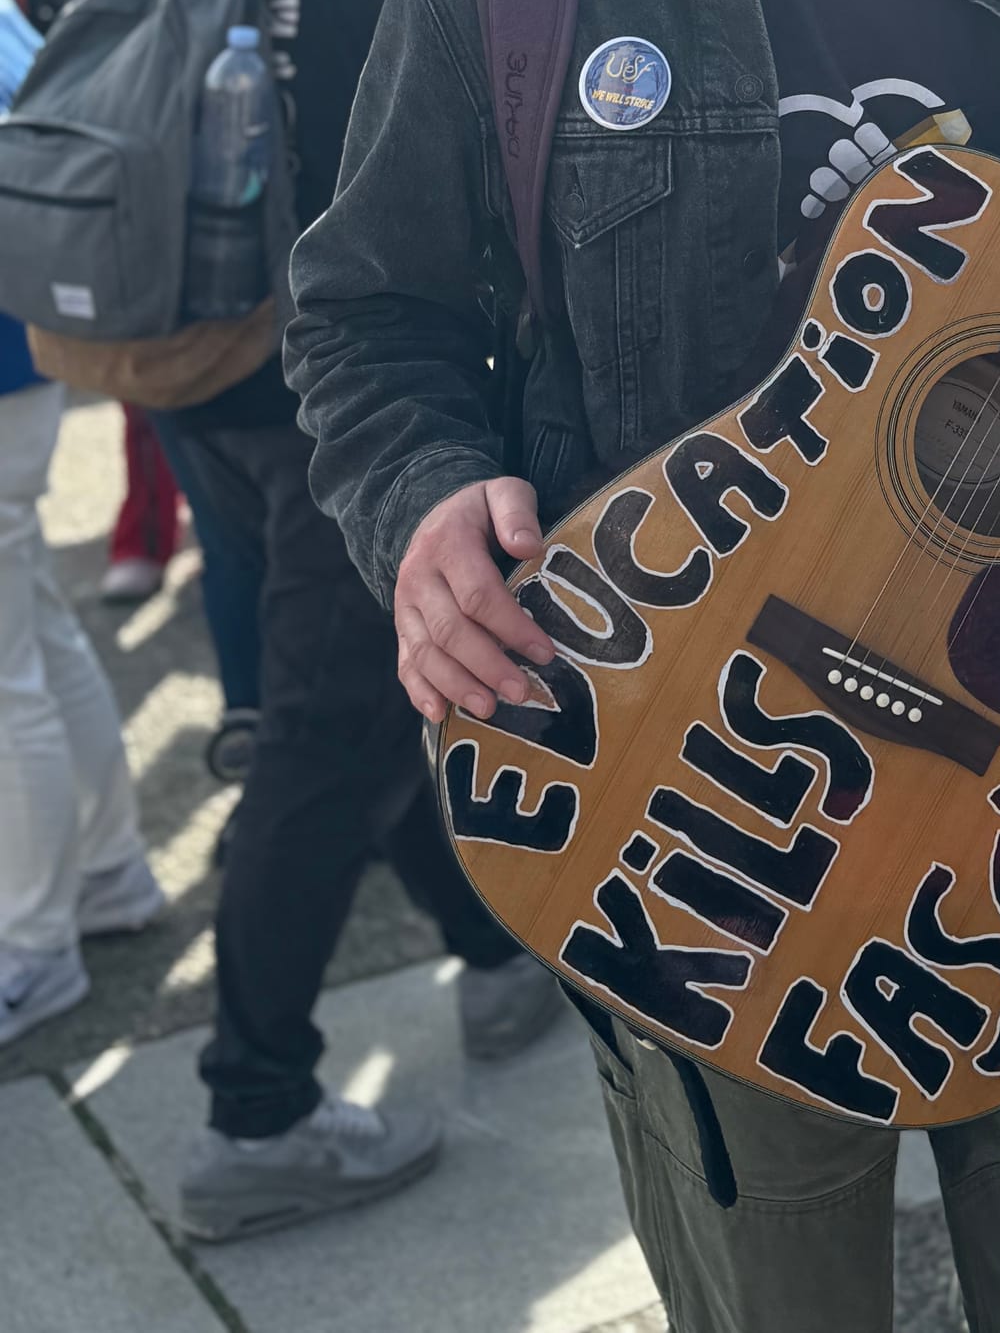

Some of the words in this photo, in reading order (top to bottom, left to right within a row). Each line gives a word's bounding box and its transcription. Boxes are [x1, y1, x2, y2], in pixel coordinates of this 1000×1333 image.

[591, 88, 606, 101] WE
[606, 92, 623, 105] WILL
[623, 96, 655, 110] STRIKE
